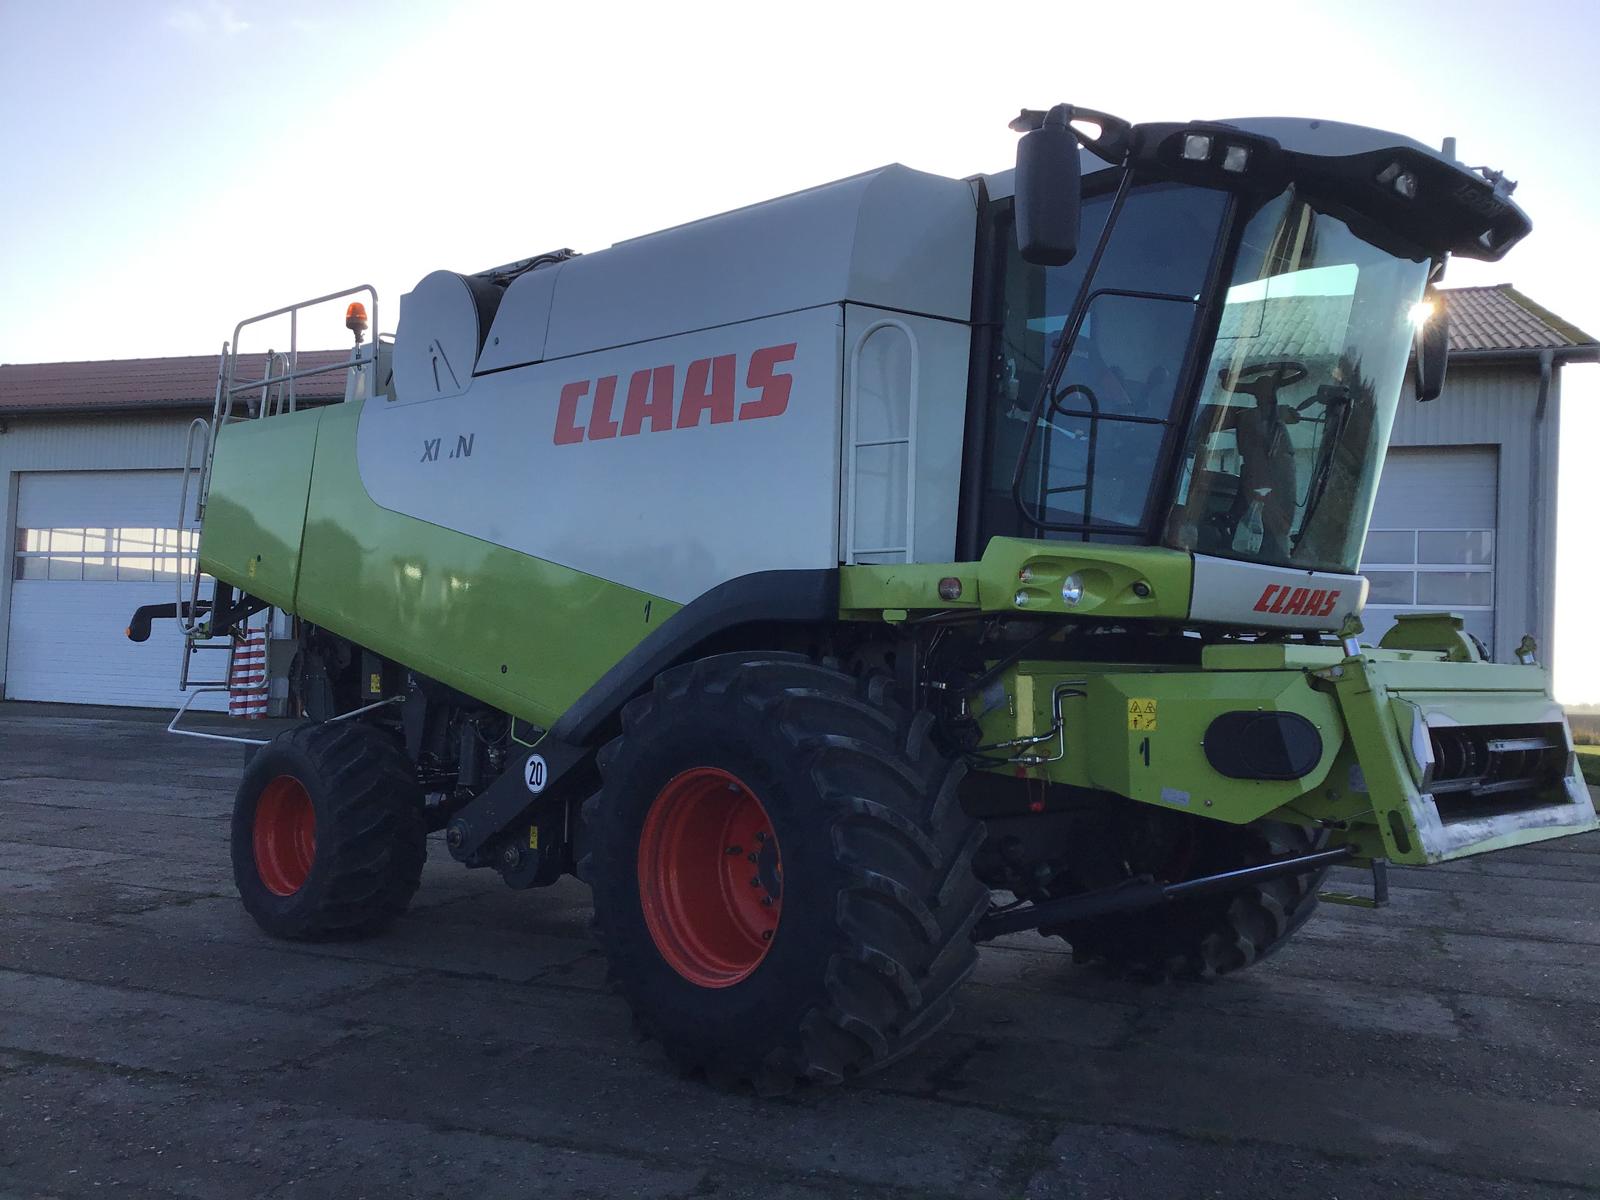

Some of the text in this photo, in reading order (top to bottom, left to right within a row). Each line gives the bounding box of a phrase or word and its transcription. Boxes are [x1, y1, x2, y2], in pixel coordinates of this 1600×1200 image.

[553, 343, 798, 446] CLAAS
[420, 433, 475, 463] XIN
[1253, 584, 1341, 617] CLAAS
[529, 760, 543, 787] 20
